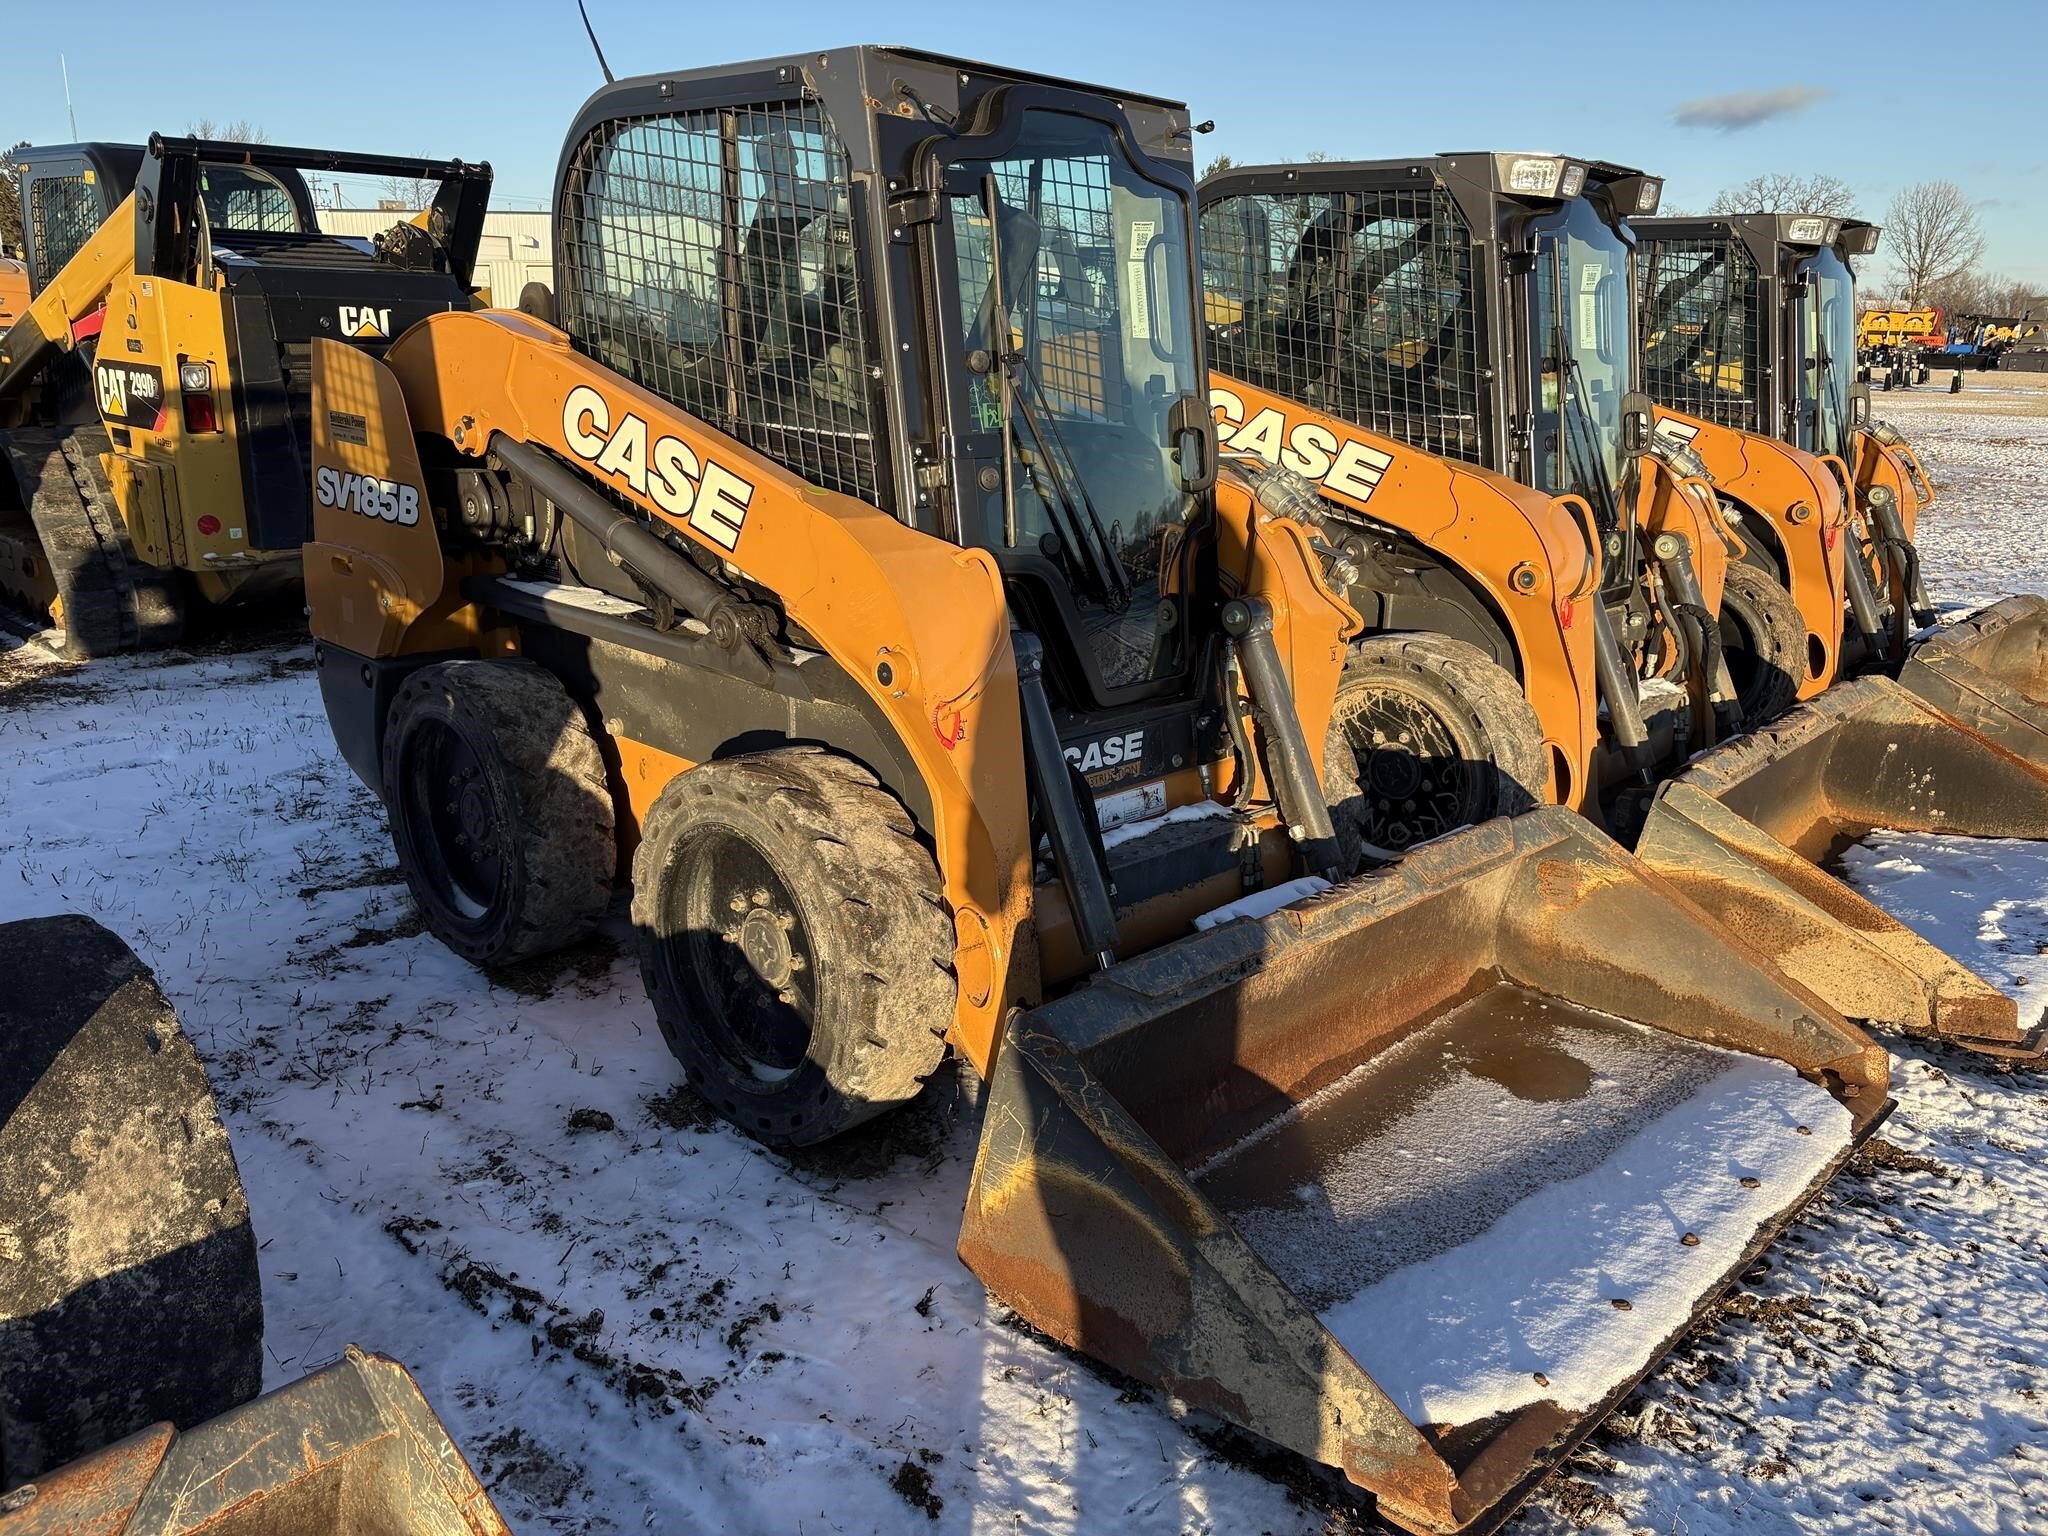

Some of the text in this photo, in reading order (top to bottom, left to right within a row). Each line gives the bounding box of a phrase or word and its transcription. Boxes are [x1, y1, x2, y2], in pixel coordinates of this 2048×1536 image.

[338, 305, 392, 338] CAT
[97, 366, 129, 418] CAT
[562, 384, 756, 554] CASE
[1208, 388, 1395, 504] CASE
[316, 465, 420, 528] SV185B
[1062, 730, 1144, 773] CASE
